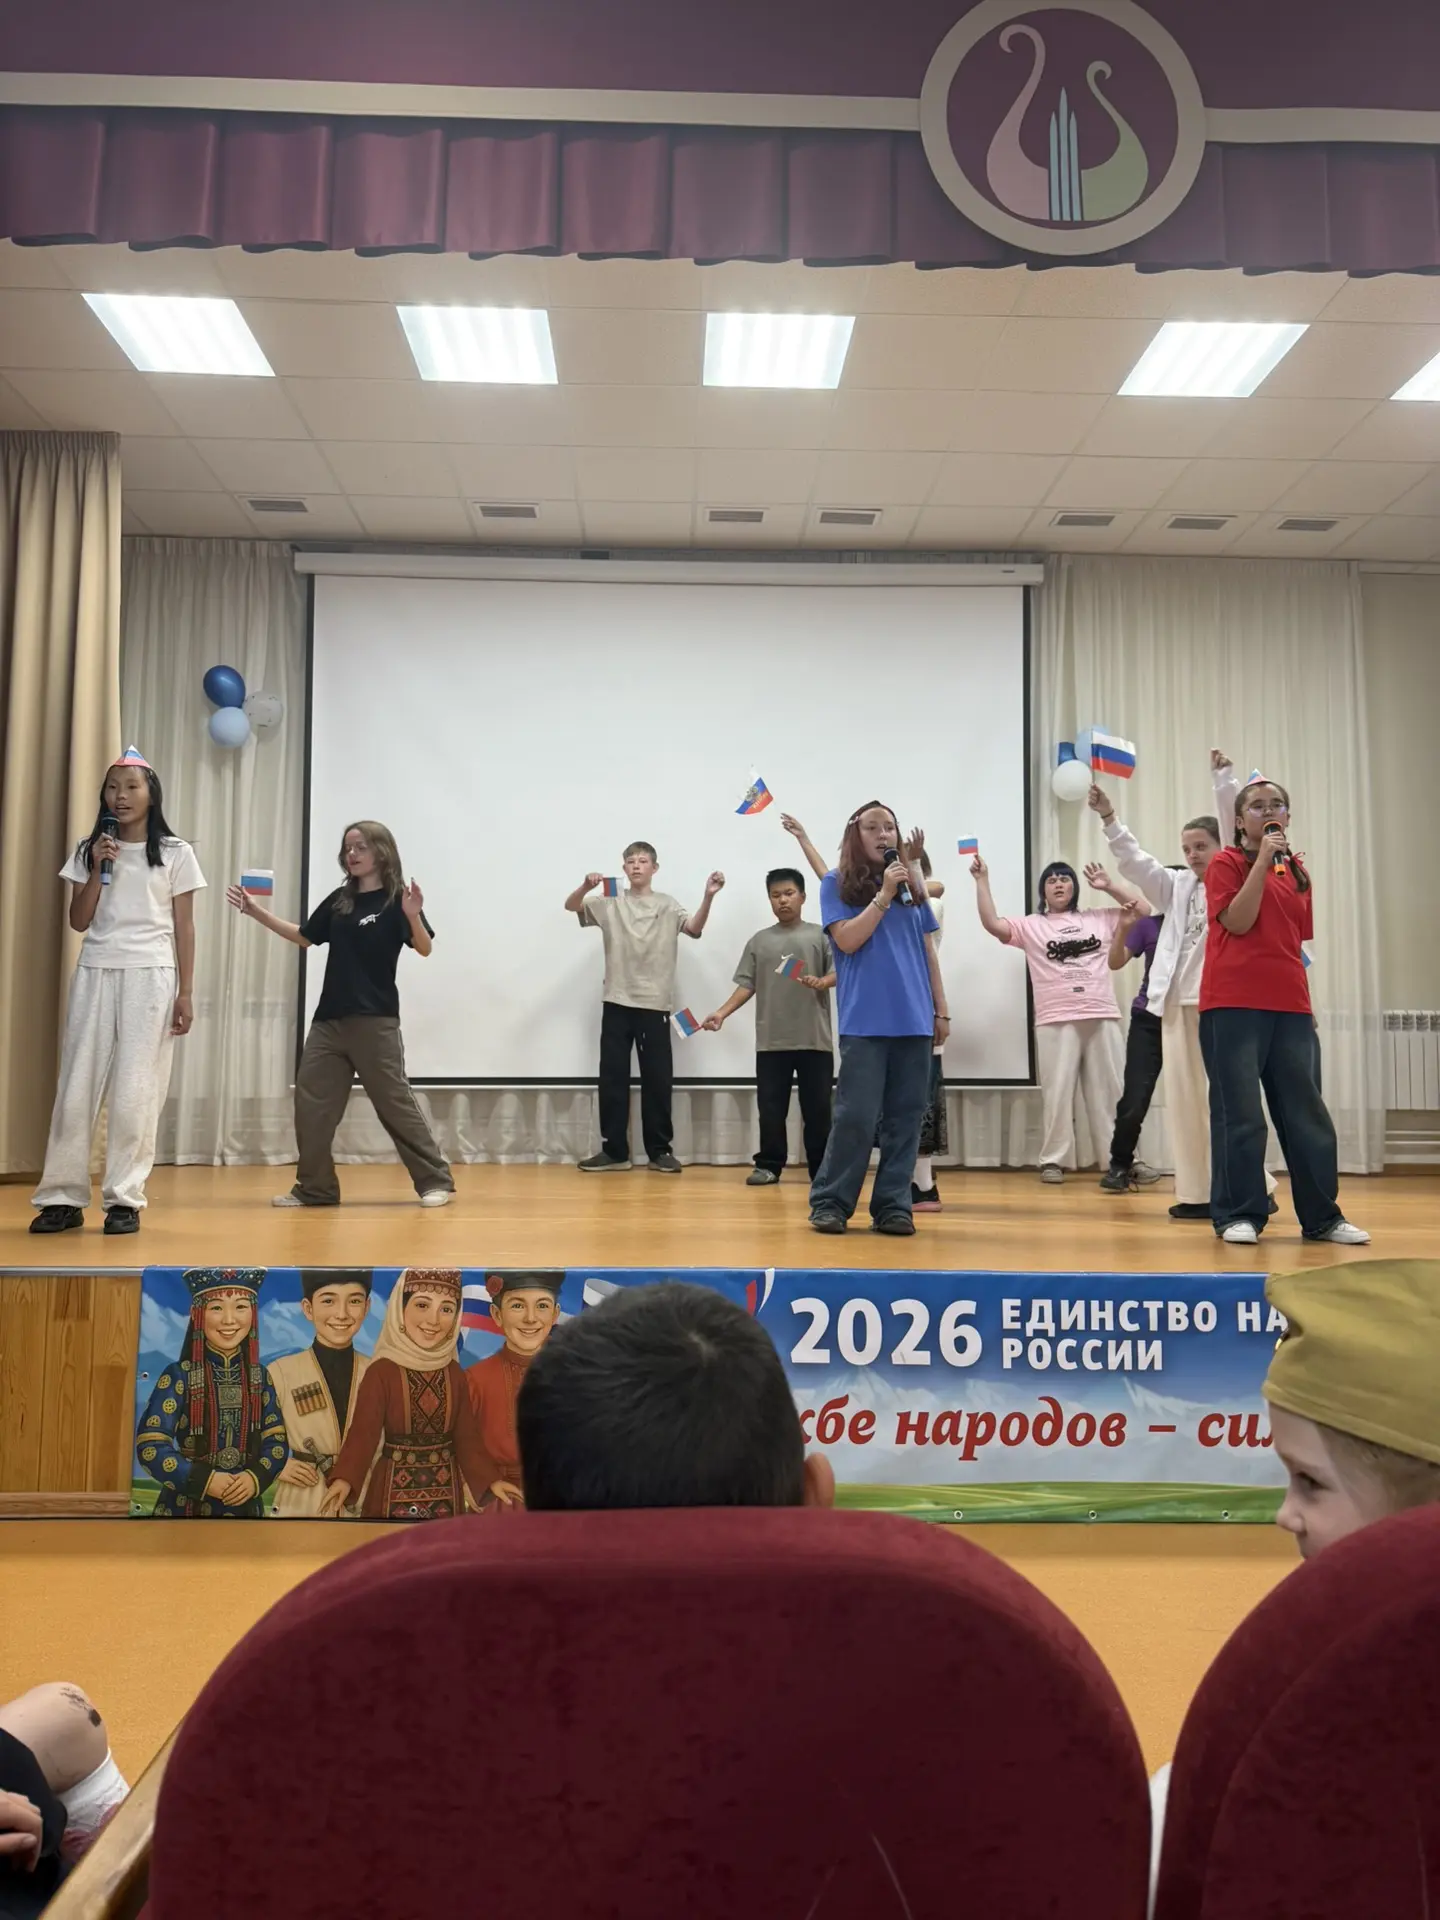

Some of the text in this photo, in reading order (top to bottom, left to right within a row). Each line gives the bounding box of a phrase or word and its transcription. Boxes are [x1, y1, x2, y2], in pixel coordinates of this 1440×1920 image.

[789, 1297, 983, 1367] 2026
[1001, 1298, 1218, 1337] ЕДИНСТВО
[1001, 1338, 1164, 1371] РОССИИ
[894, 1396, 1128, 1462] народов
[1197, 1412, 1274, 1448] си
